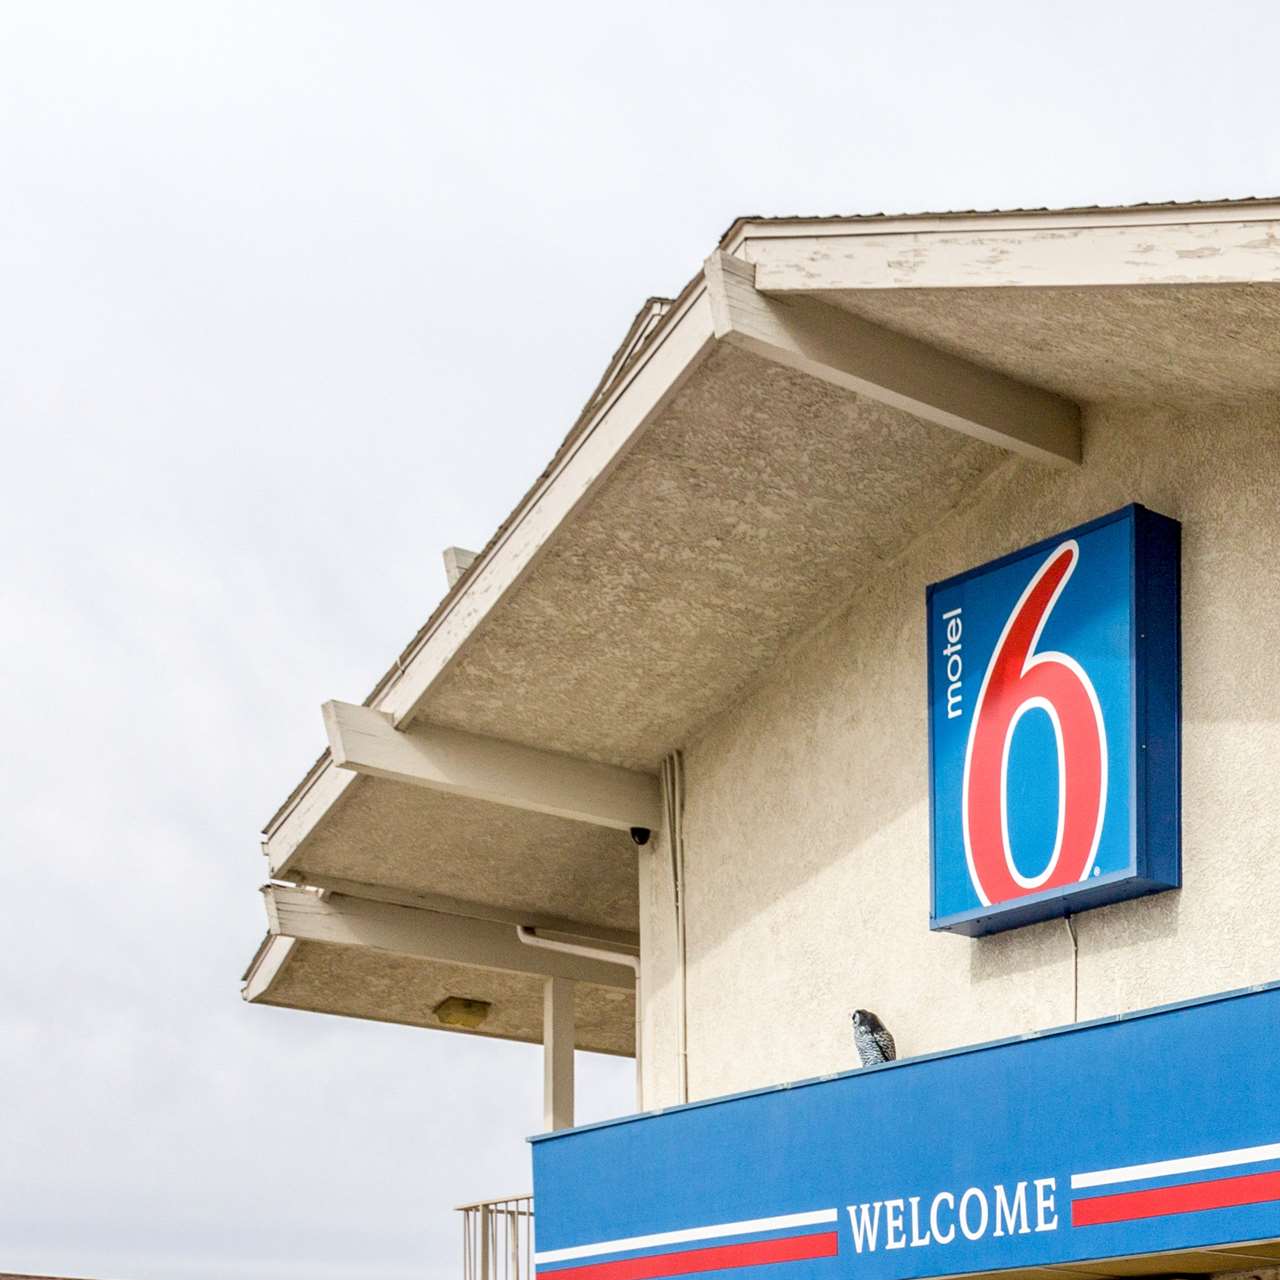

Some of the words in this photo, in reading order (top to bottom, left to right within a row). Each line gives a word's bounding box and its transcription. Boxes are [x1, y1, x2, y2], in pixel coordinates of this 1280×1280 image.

[943, 608, 962, 719] motel
[962, 539, 1108, 907] 6
[846, 1177, 1059, 1254] WELCOME
